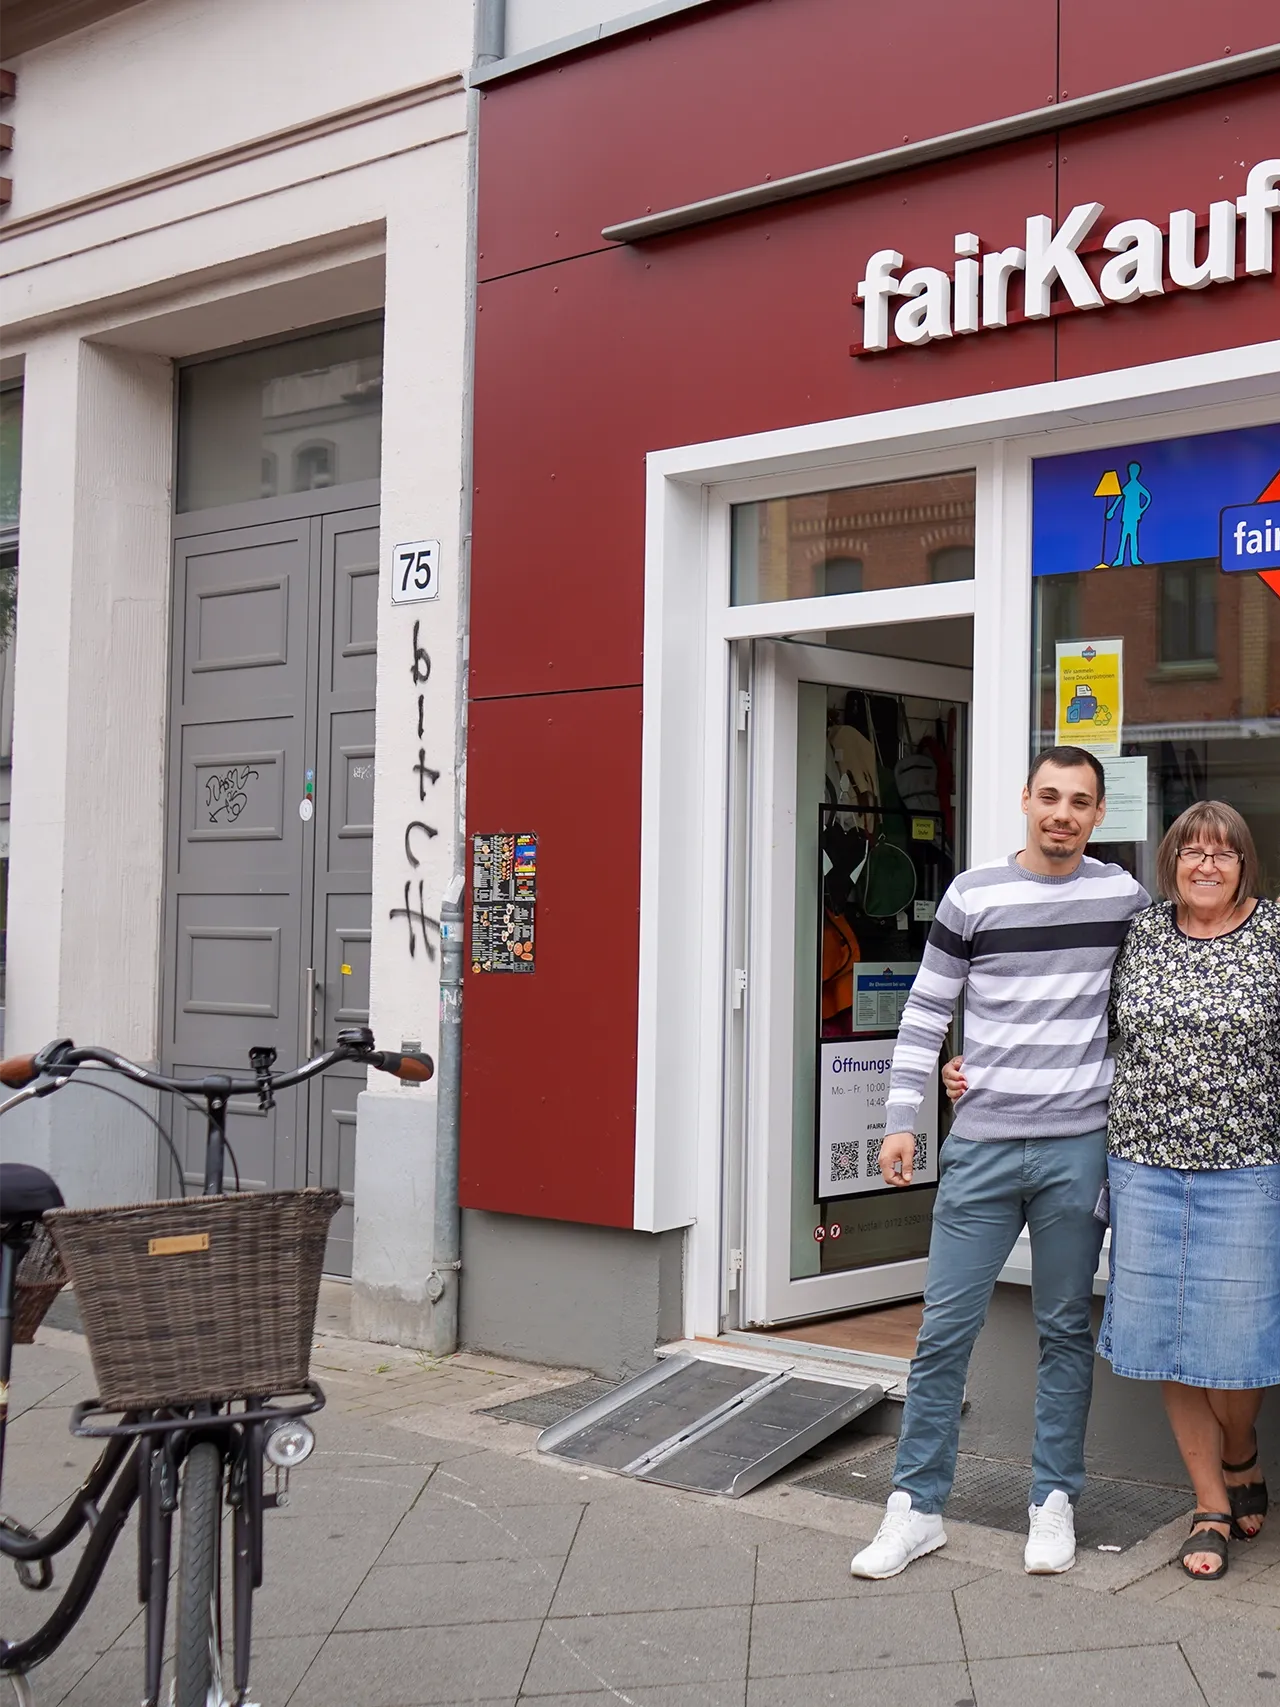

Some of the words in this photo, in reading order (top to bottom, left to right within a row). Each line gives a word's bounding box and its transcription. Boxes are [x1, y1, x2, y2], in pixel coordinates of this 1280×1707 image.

[399, 549, 432, 591] 75
[832, 1056, 893, 1074] Öffnungs
[831, 1086, 846, 1096] Mo.
[866, 1082, 886, 1093] 10:00
[866, 1097, 886, 1107] 14:45
